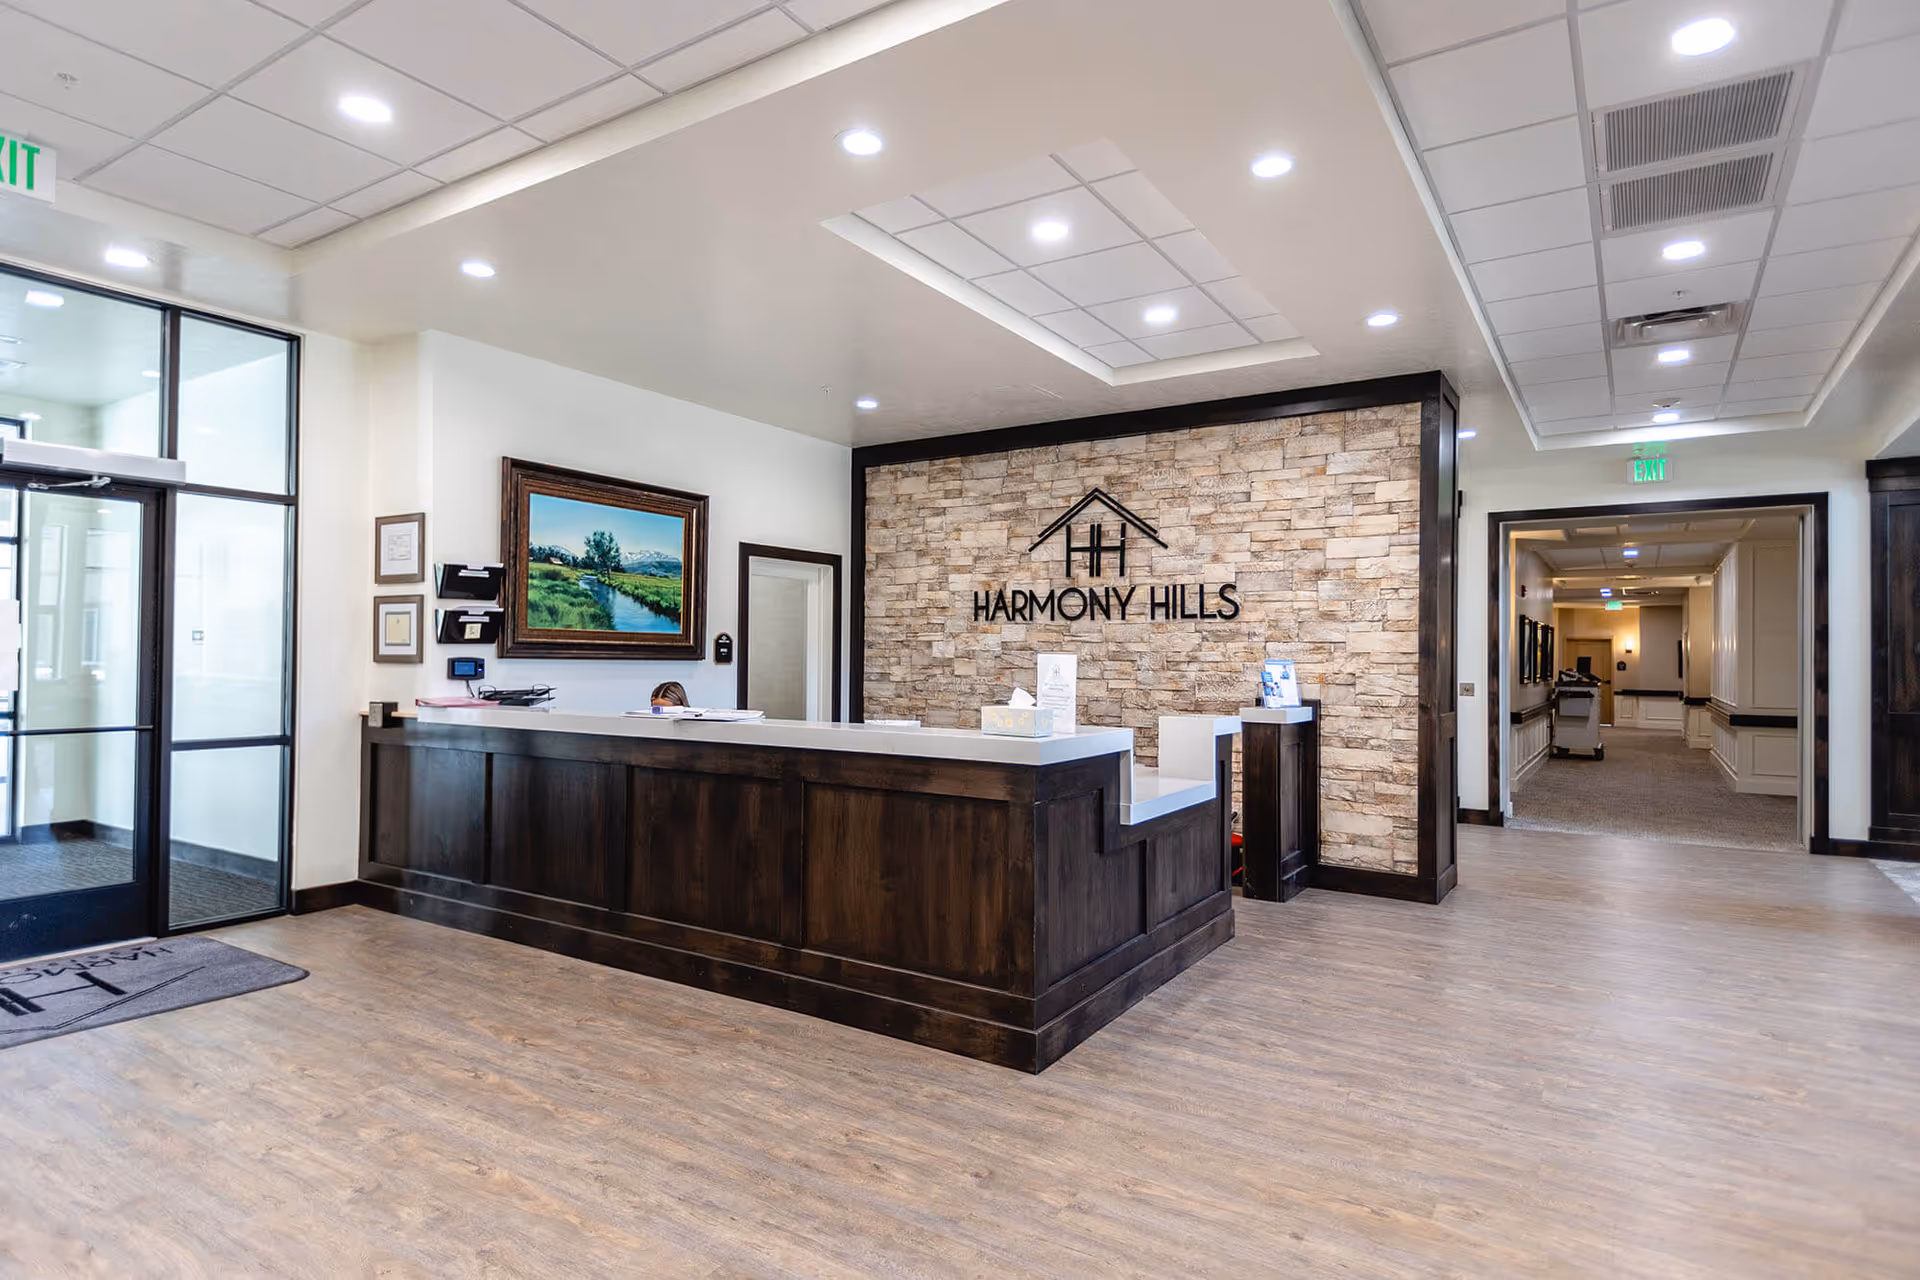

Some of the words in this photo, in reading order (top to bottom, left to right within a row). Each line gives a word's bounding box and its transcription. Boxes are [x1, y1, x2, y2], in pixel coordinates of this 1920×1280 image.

[0, 136, 41, 190] IT
[1634, 458, 1667, 482] EXIT
[974, 585, 1136, 621] HARMONY
[1150, 583, 1240, 620] HILLS
[0, 947, 173, 985] HARMO
